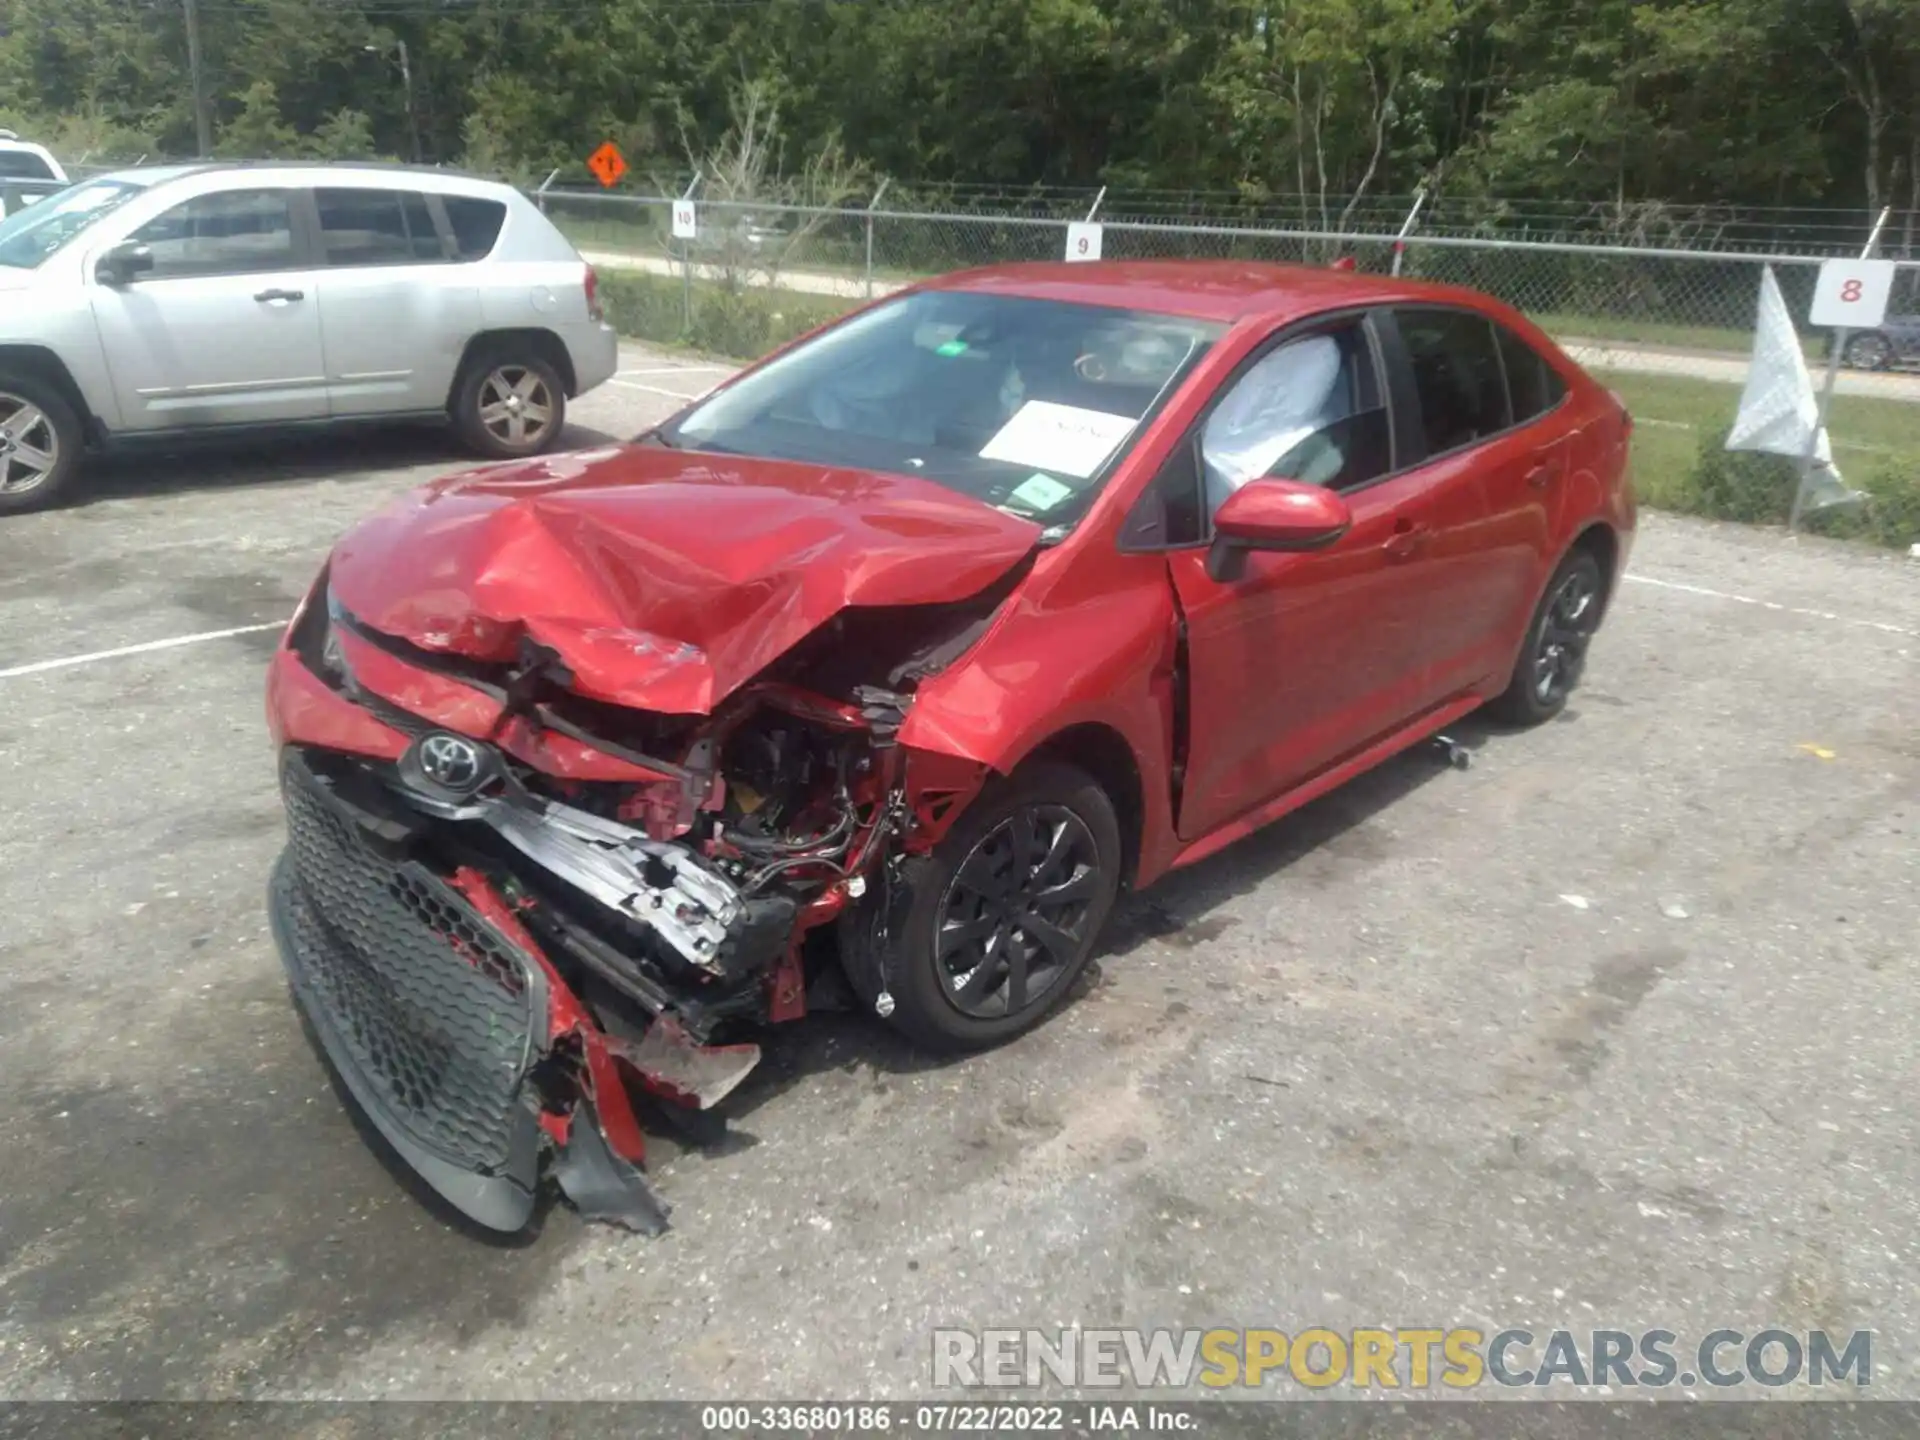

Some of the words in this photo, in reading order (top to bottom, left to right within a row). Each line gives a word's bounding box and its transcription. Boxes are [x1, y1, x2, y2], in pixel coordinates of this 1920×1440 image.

[678, 211, 692, 226] 10
[1078, 237, 1089, 255] 9
[1841, 279, 1863, 302] 8
